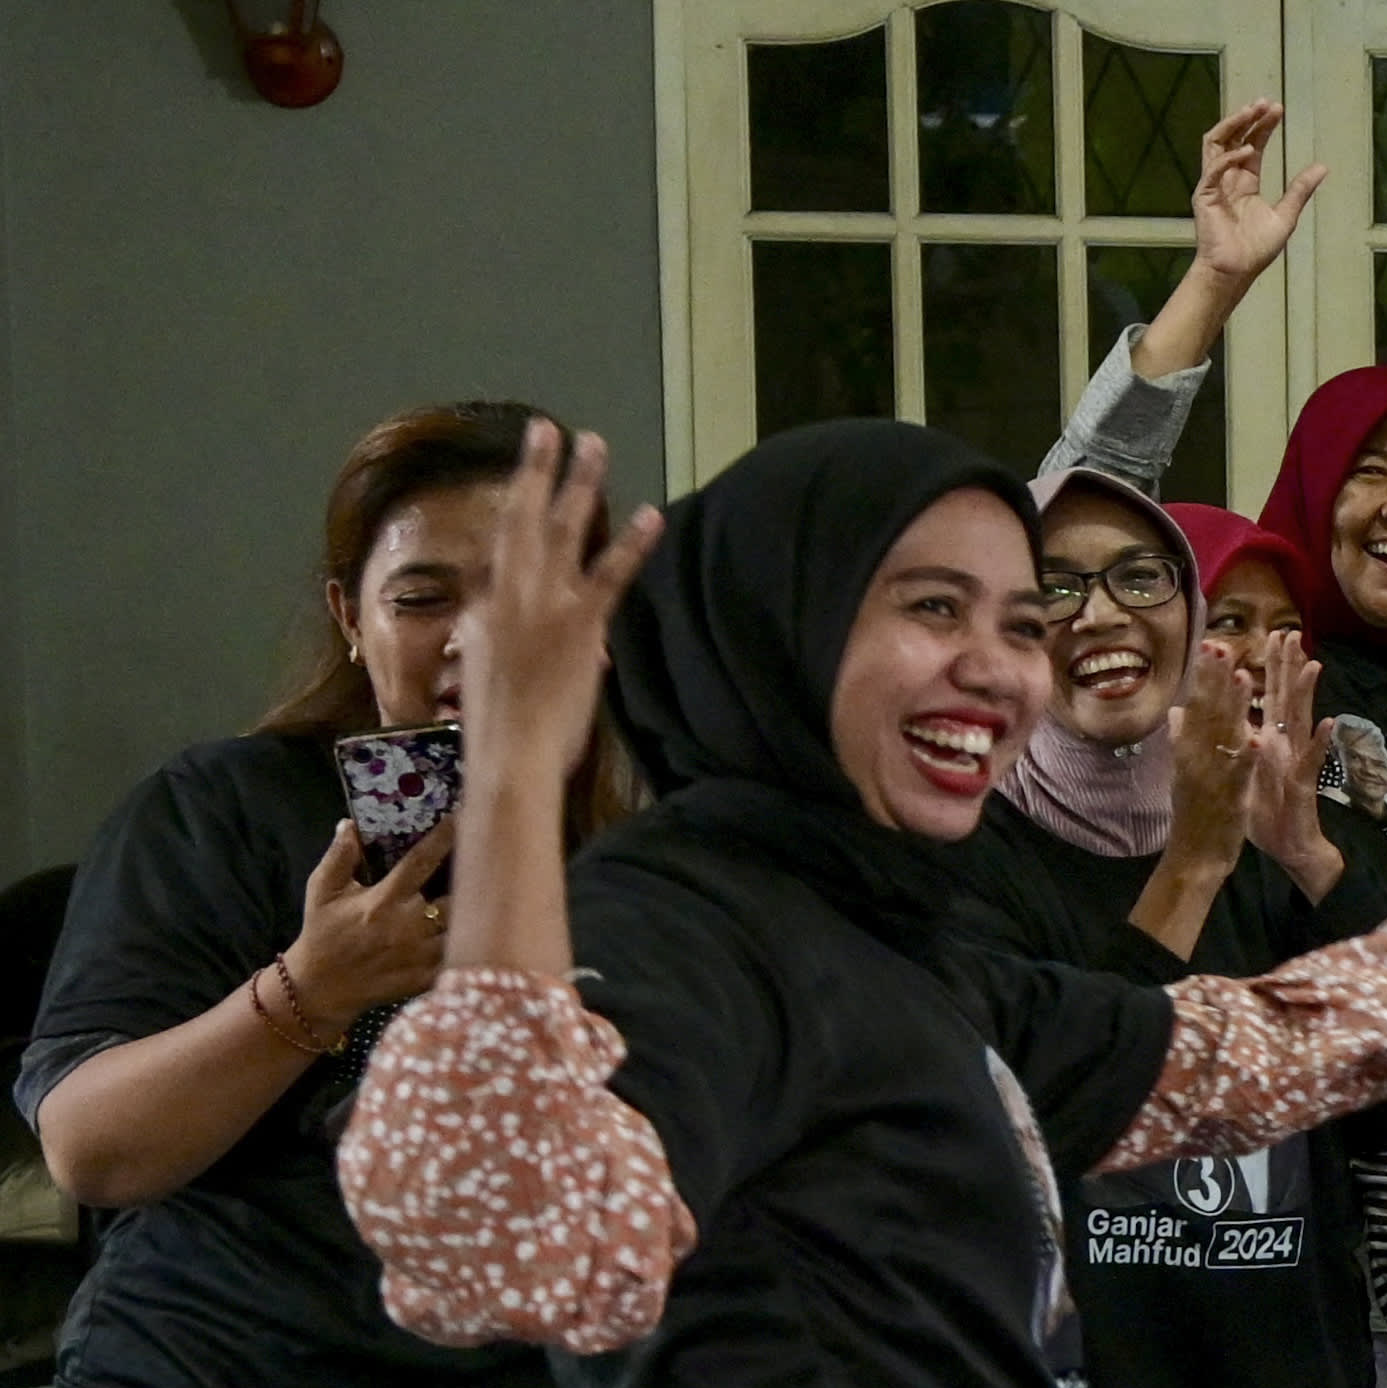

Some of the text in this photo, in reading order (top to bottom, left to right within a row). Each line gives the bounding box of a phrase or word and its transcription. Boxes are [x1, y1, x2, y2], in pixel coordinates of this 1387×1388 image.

[1187, 1156, 1222, 1212] 3
[1087, 1209, 1188, 1243] Ganjar
[1089, 1226, 1294, 1267] Mahfud 2024
